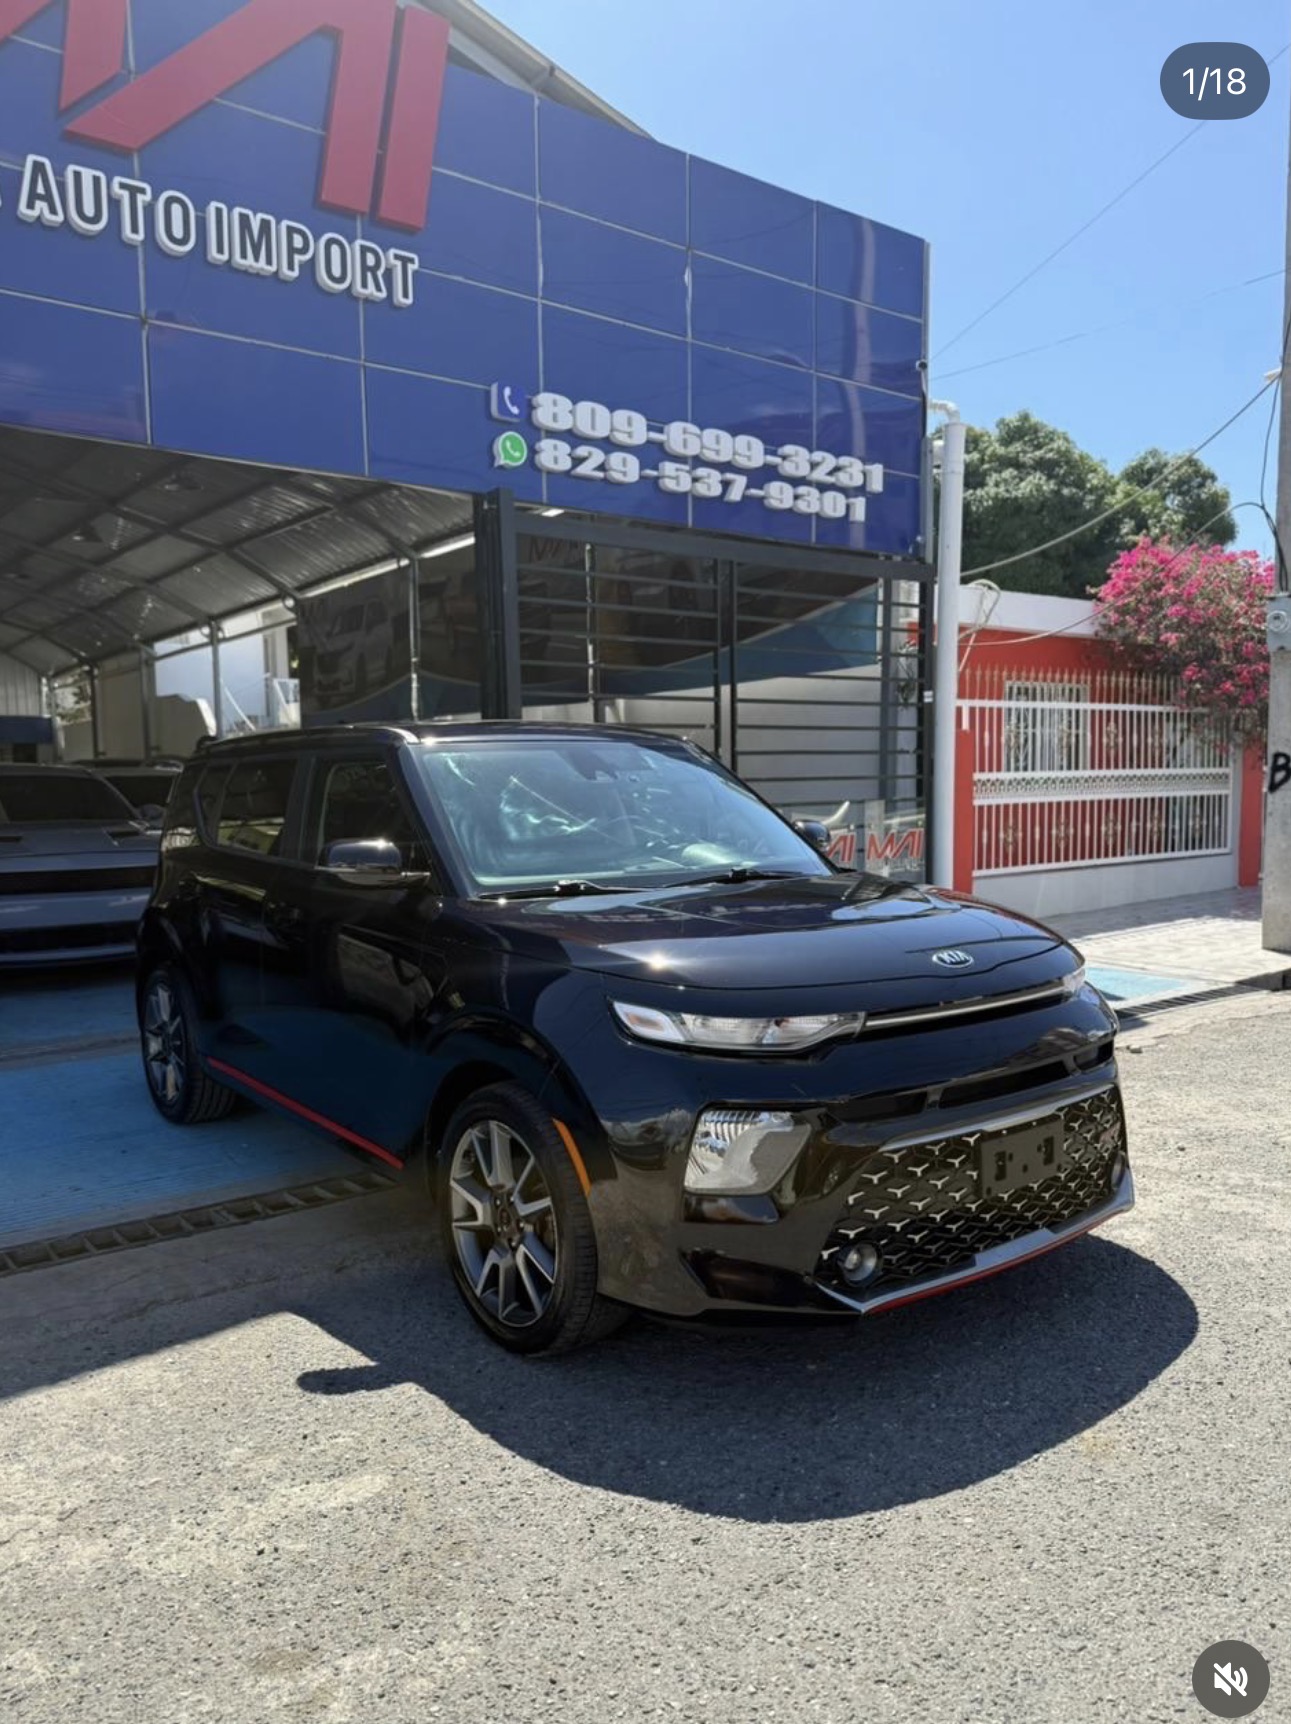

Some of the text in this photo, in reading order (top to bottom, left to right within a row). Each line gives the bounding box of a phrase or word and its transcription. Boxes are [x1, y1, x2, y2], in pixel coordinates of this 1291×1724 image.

[18, 154, 419, 307] AUTO IMPORT
[532, 391, 884, 494] 809-699-3231
[535, 438, 867, 523] 829-537-9301
